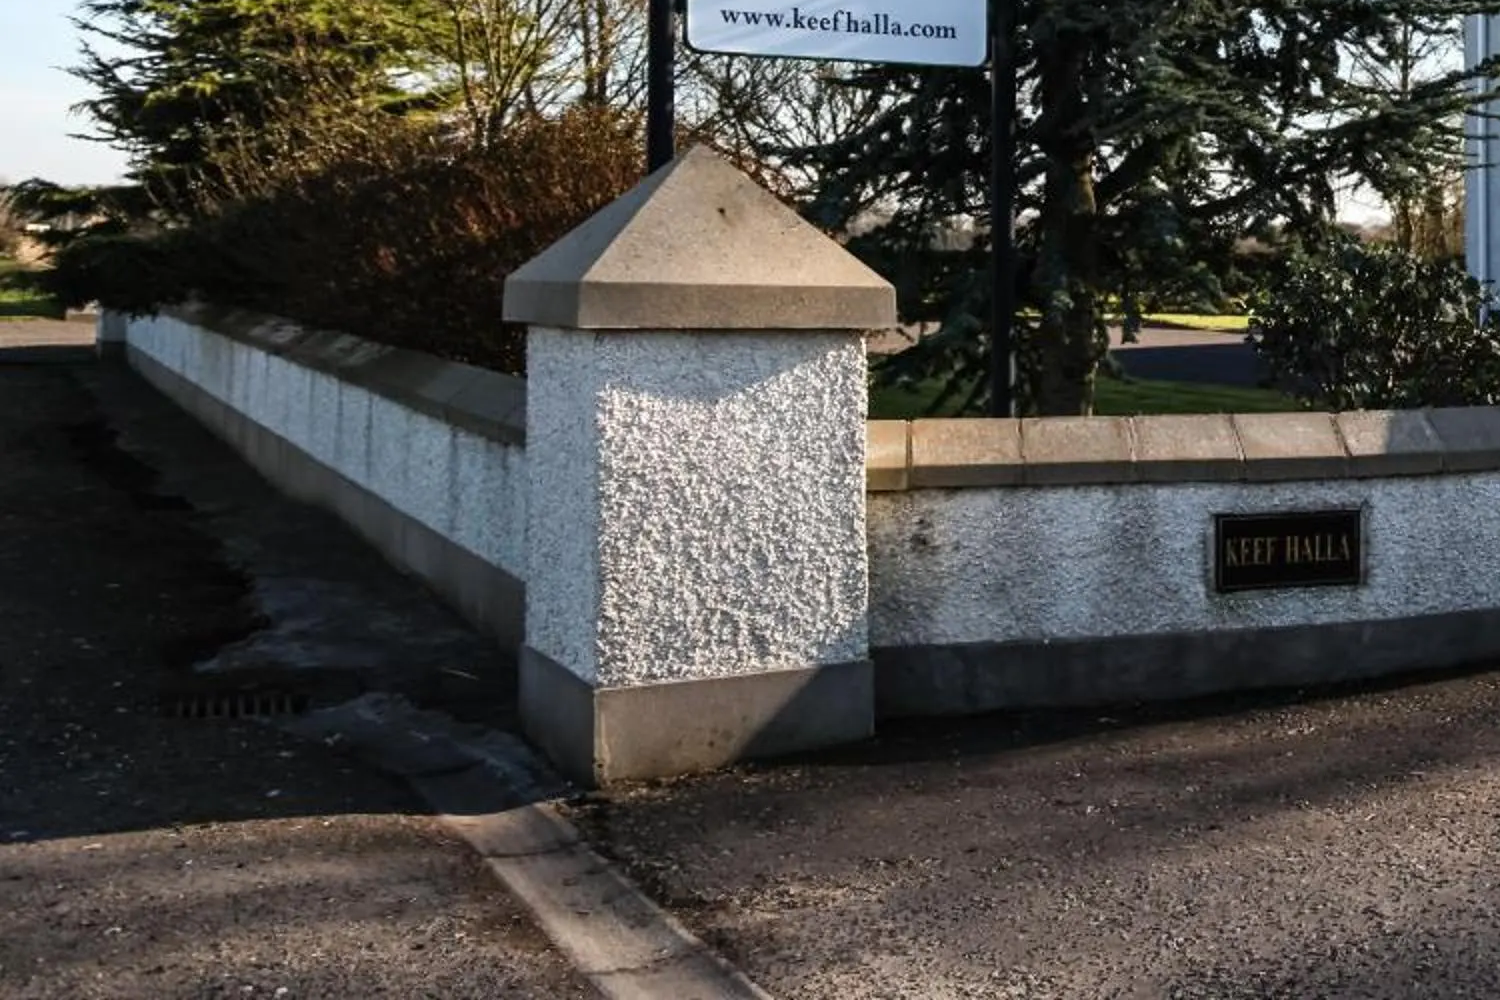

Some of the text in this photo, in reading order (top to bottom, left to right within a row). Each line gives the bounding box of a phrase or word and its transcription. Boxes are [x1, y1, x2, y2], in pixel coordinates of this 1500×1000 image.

[720, 7, 958, 39] www.keefhalla.com
[1225, 534, 1352, 567] KEEF HALLA
